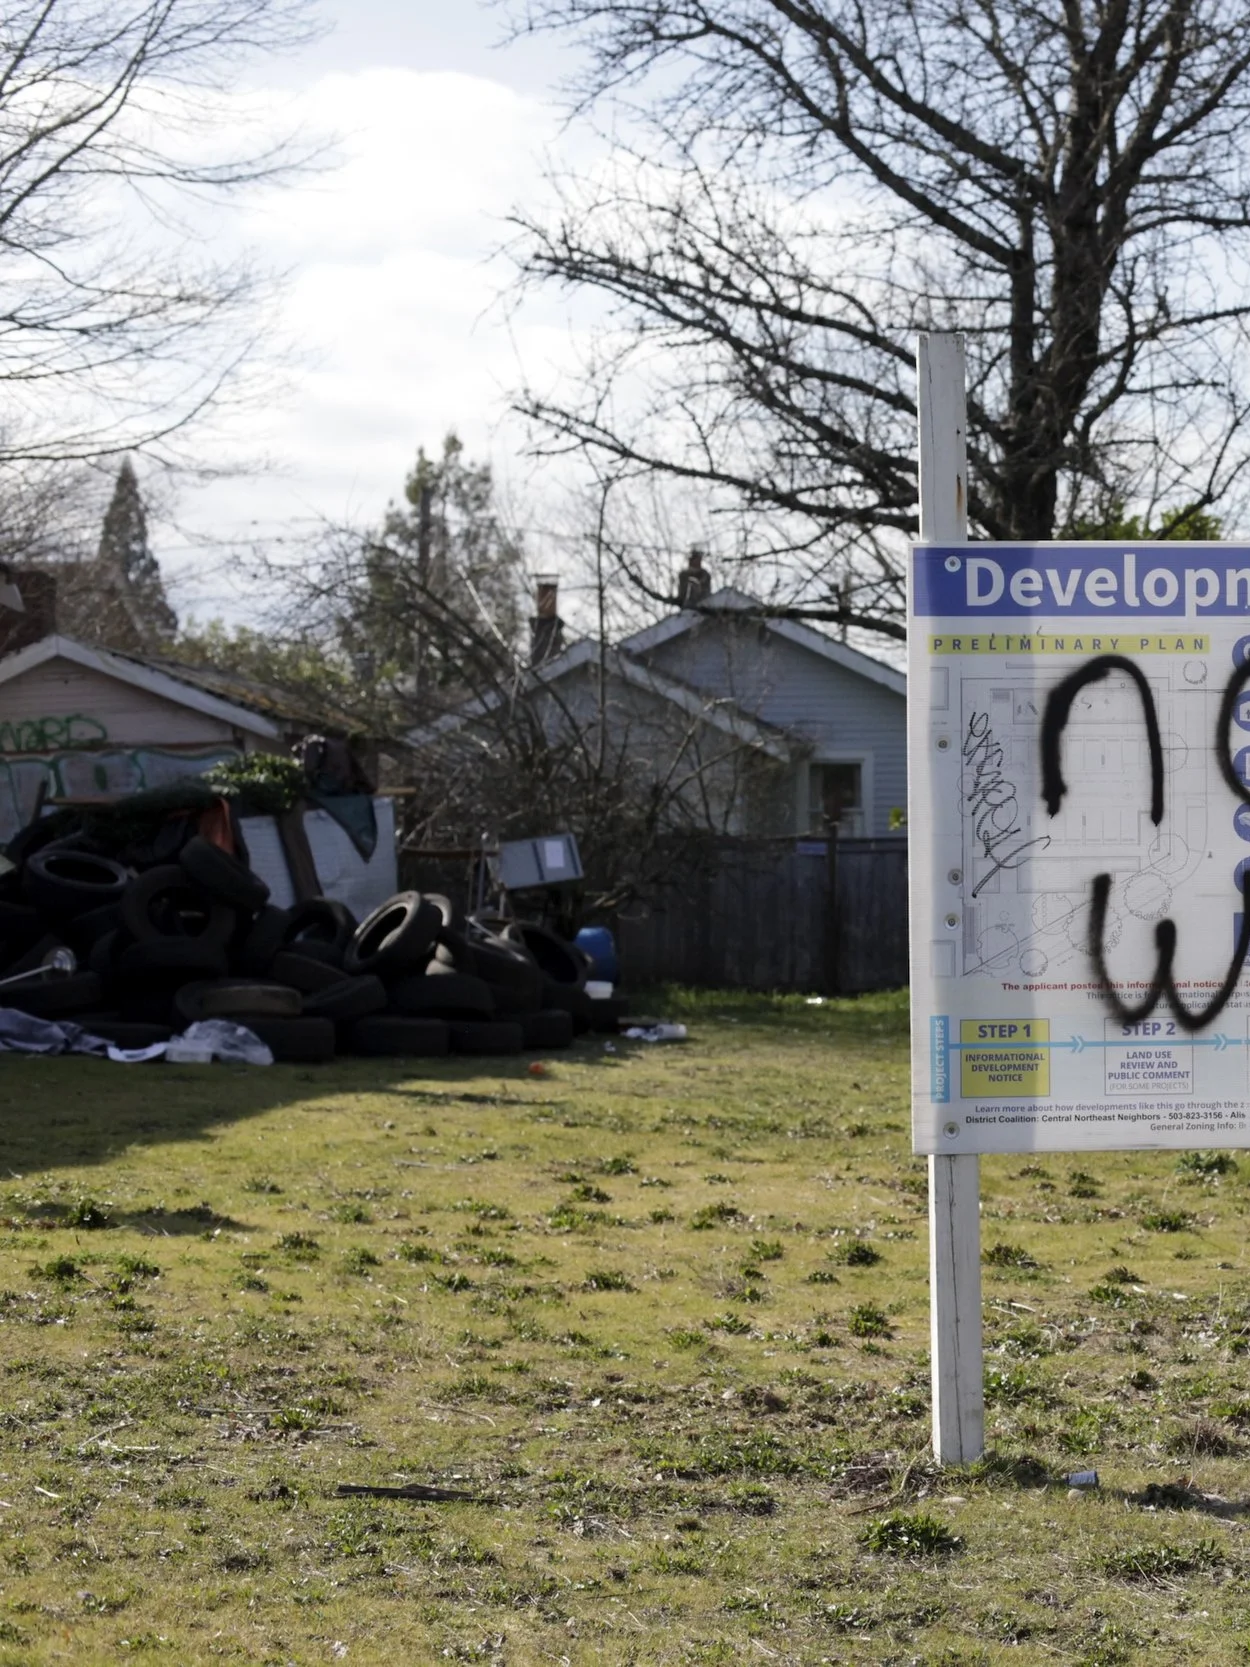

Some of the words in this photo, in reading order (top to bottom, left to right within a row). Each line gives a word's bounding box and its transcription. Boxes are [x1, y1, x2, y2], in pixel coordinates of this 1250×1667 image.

[933, 638, 1119, 651] PRELIMINARY
[1140, 638, 1203, 651] PLAN
[1001, 983, 1024, 991] The
[1027, 982, 1068, 992] applicant
[1193, 980, 1224, 989] notice
[977, 1024, 1020, 1038] STEP
[1022, 1024, 1032, 1038] 1
[1122, 1022, 1162, 1036] STEP
[1166, 1022, 1176, 1036] 2
[935, 1019, 945, 1056] STEPS
[965, 1052, 1046, 1063] INFORMATIONAL
[1126, 1051, 1152, 1060] LAND
[1154, 1051, 1172, 1060] USE
[971, 1062, 1040, 1073] DEVELOPMENT
[1120, 1061, 1151, 1070] REVIEW
[1153, 1060, 1178, 1070] AND
[935, 1057, 946, 1099] PROJECT
[988, 1073, 1023, 1083] NOTICE
[1108, 1071, 1140, 1080] PUBLIC
[1142, 1070, 1190, 1080] COMMENT
[1109, 1082, 1127, 1092] (FOR
[1128, 1082, 1147, 1091] SOME
[1147, 1081, 1189, 1092] PROJECTS)
[975, 1105, 1001, 1113] Learn
[1002, 1105, 1026, 1113] more
[1027, 1104, 1053, 1112] about
[1055, 1103, 1074, 1112] how
[1075, 1102, 1137, 1113] developments
[1139, 1102, 1155, 1111] like
[1156, 1102, 1173, 1110] this
[1174, 1103, 1185, 1112] go
[1187, 1101, 1222, 1111] through
[1223, 1101, 1239, 1109] the
[965, 1114, 997, 1124] District
[998, 1114, 1039, 1124] Coalition:
[1041, 1114, 1072, 1123] Central
[1074, 1113, 1116, 1122] Northeast
[1117, 1112, 1161, 1122] Neighbors
[1168, 1110, 1223, 1120] 503-823-3156
[1150, 1122, 1185, 1132] General
[1185, 1122, 1215, 1132] Zoning
[1217, 1121, 1237, 1130] Info:
